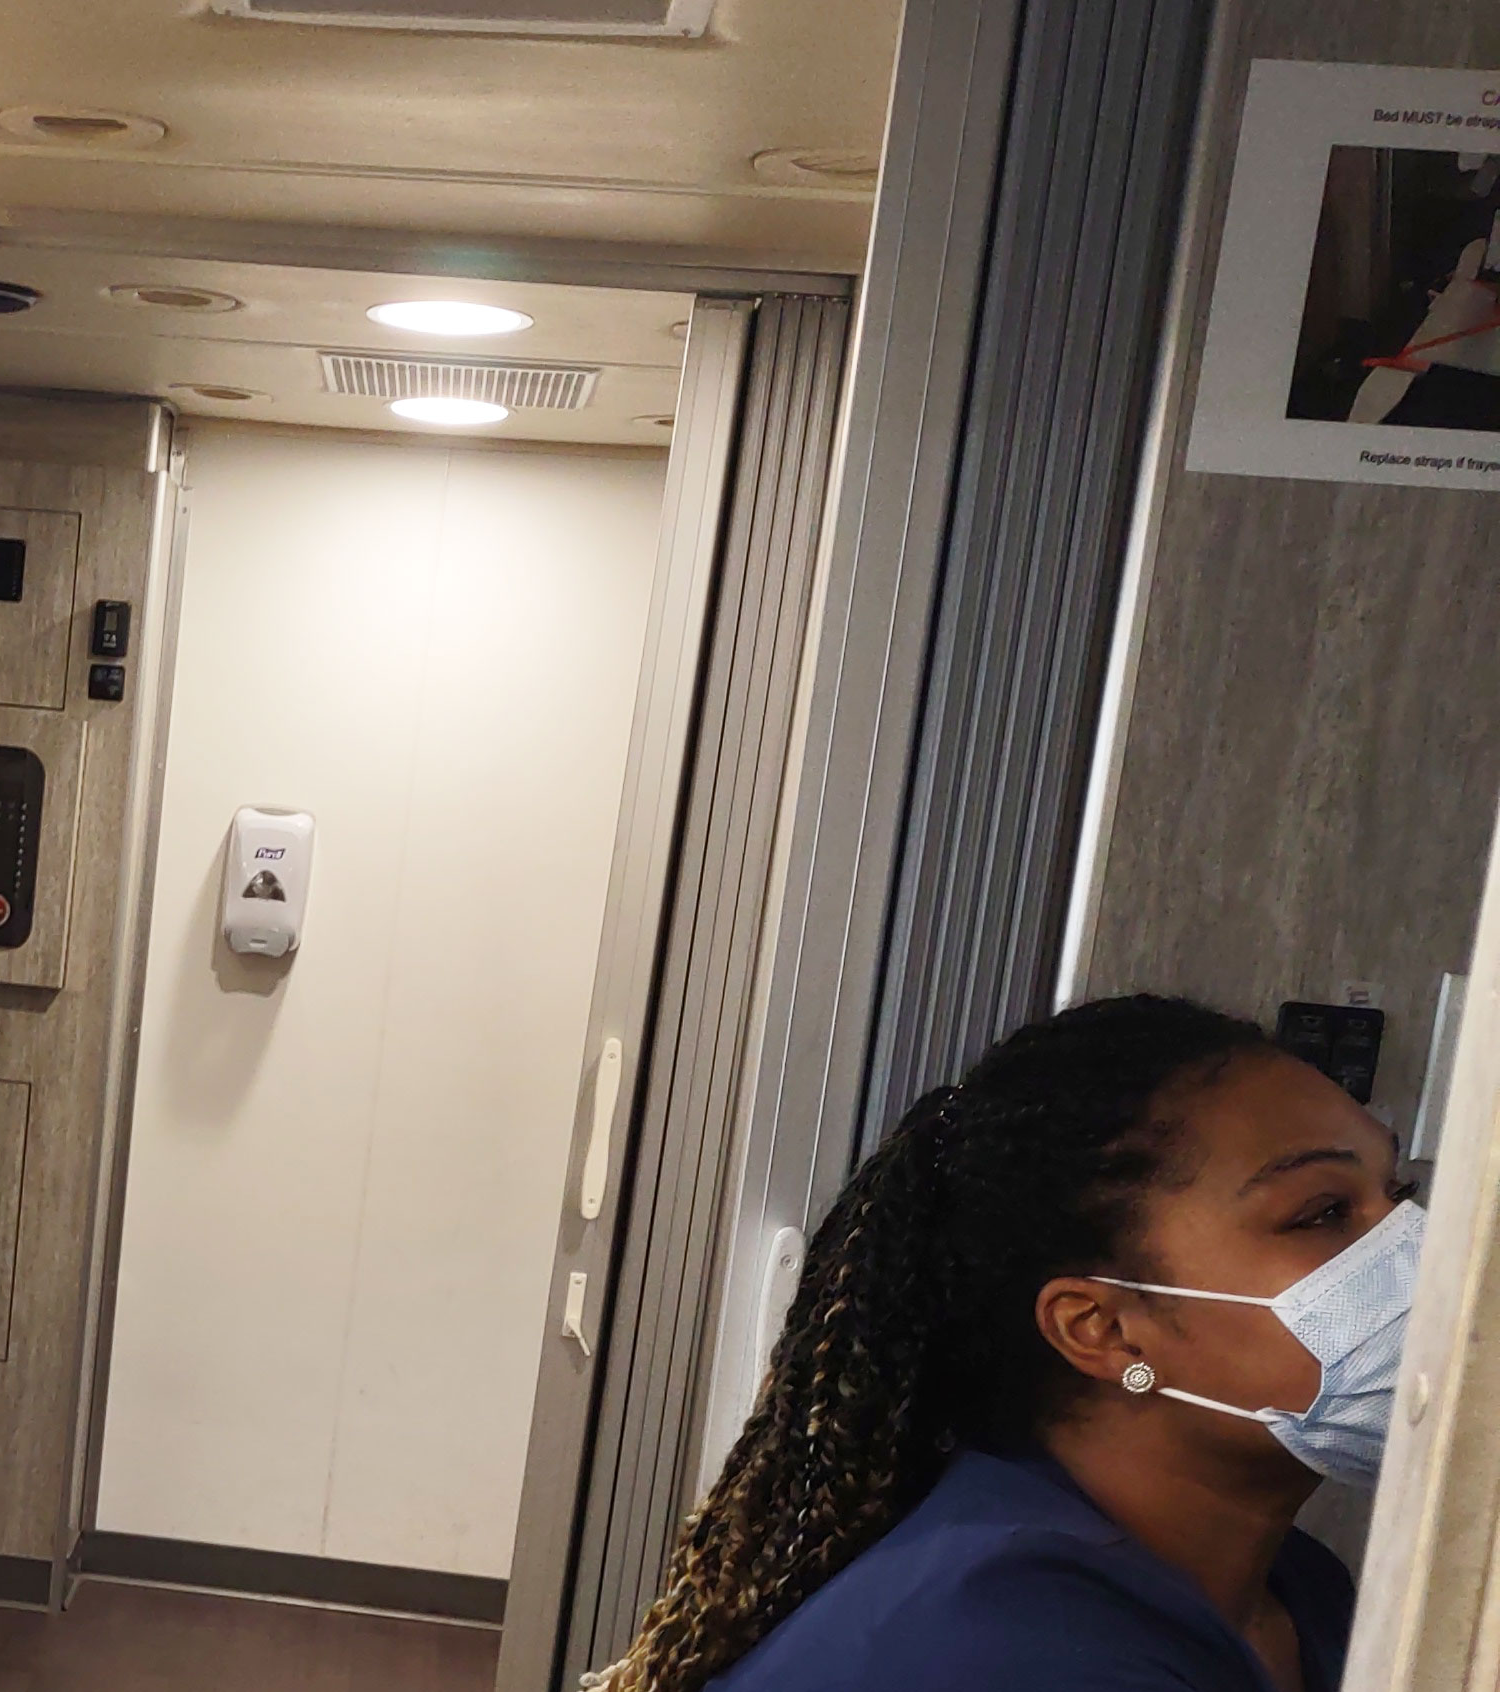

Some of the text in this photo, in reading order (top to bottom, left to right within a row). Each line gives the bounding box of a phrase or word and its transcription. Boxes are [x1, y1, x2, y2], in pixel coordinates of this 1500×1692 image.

[1373, 109, 1399, 121] Bed
[1402, 111, 1443, 124] MUST
[1446, 114, 1462, 125] be
[1360, 450, 1411, 465] Replace
[1414, 456, 1452, 470] straps
[1456, 457, 1465, 468] if
